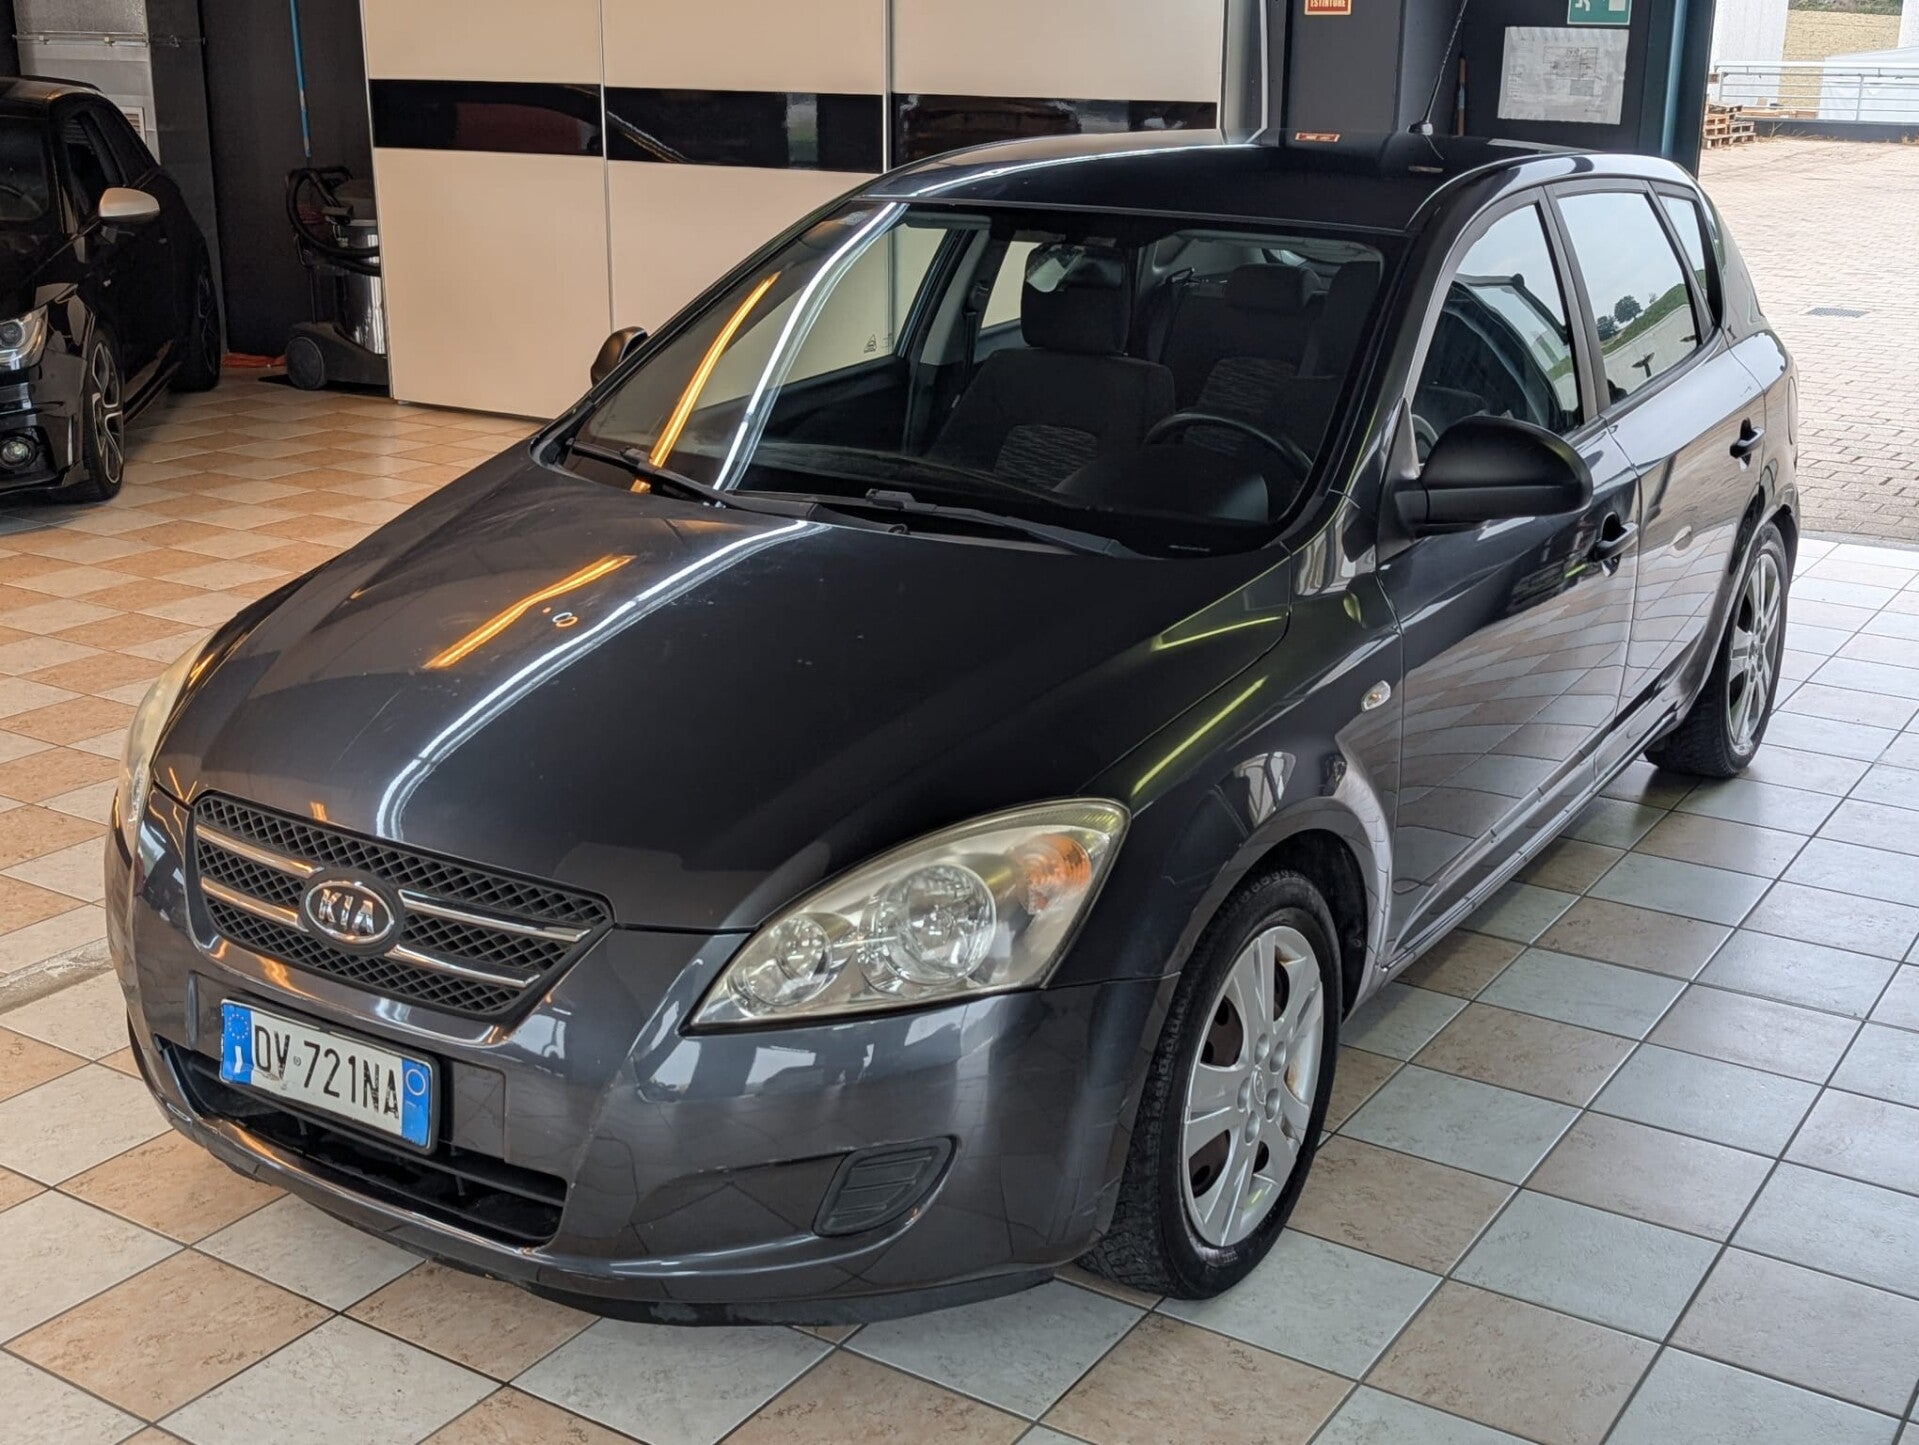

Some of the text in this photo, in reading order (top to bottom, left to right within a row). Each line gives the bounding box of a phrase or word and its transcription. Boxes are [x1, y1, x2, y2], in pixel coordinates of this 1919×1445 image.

[318, 889, 375, 934] KIA
[254, 1025, 400, 1120] DV 721NA
